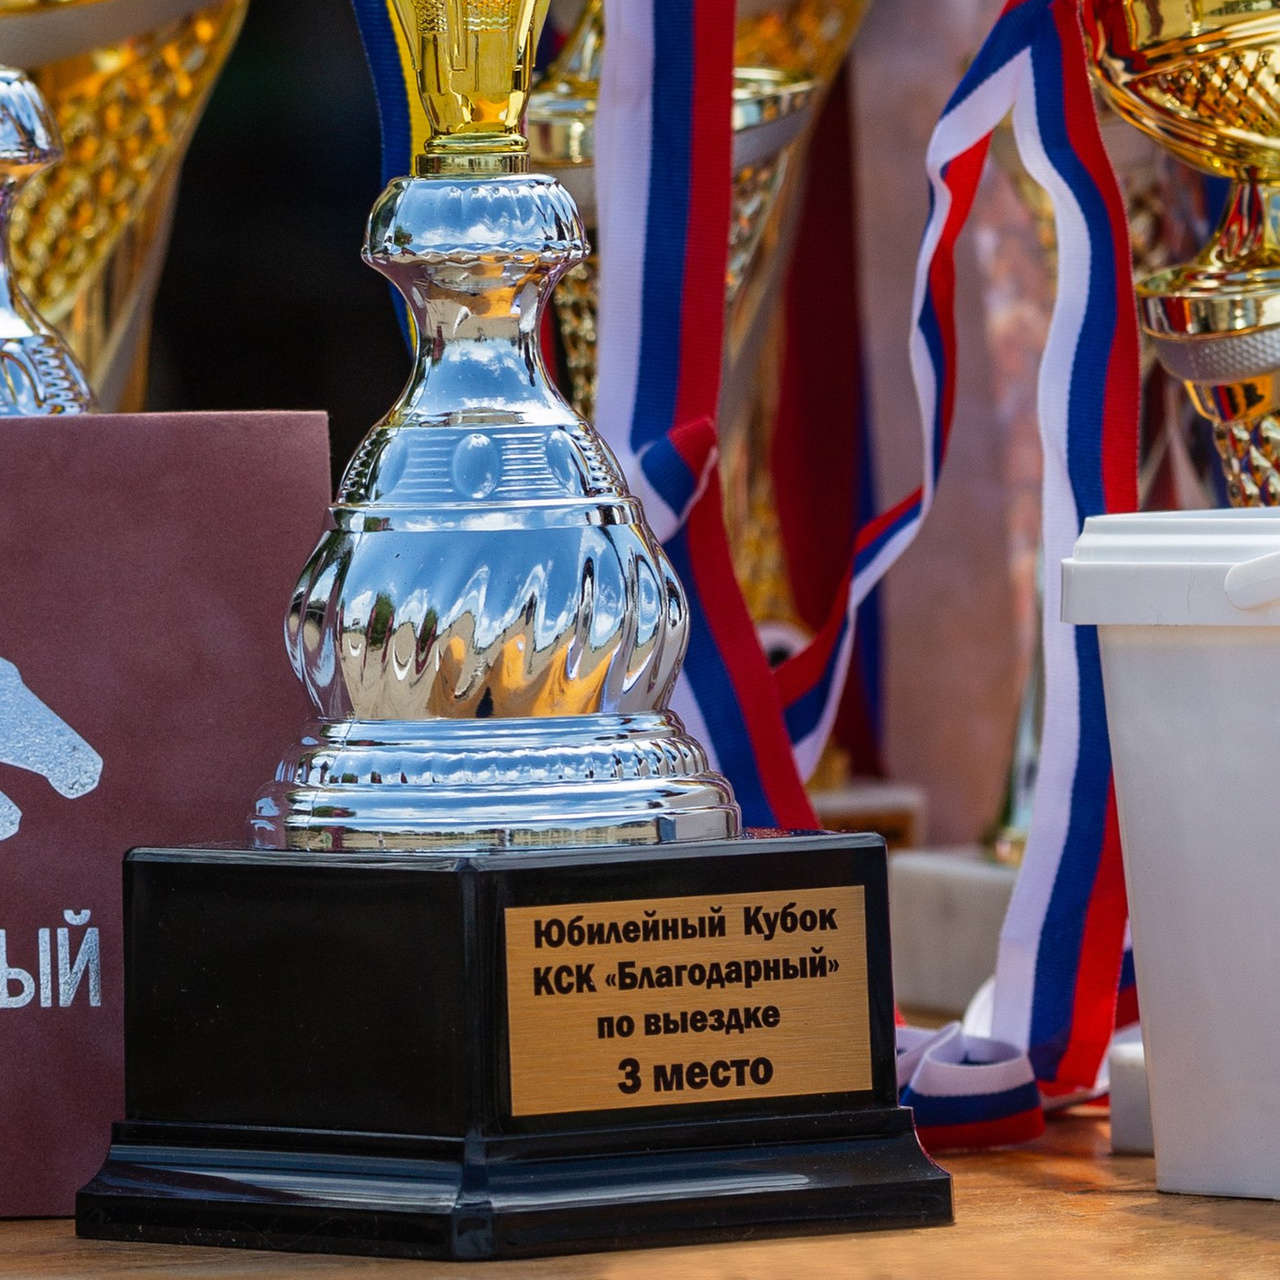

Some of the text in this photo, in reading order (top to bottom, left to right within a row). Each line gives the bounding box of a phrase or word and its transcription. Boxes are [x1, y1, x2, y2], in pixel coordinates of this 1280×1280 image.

[533, 902, 838, 949] Юбилейный Кубок
[533, 946, 840, 996] КСК «Благодарный»
[596, 1004, 781, 1039] по выездке
[617, 1056, 774, 1095] 3 место
